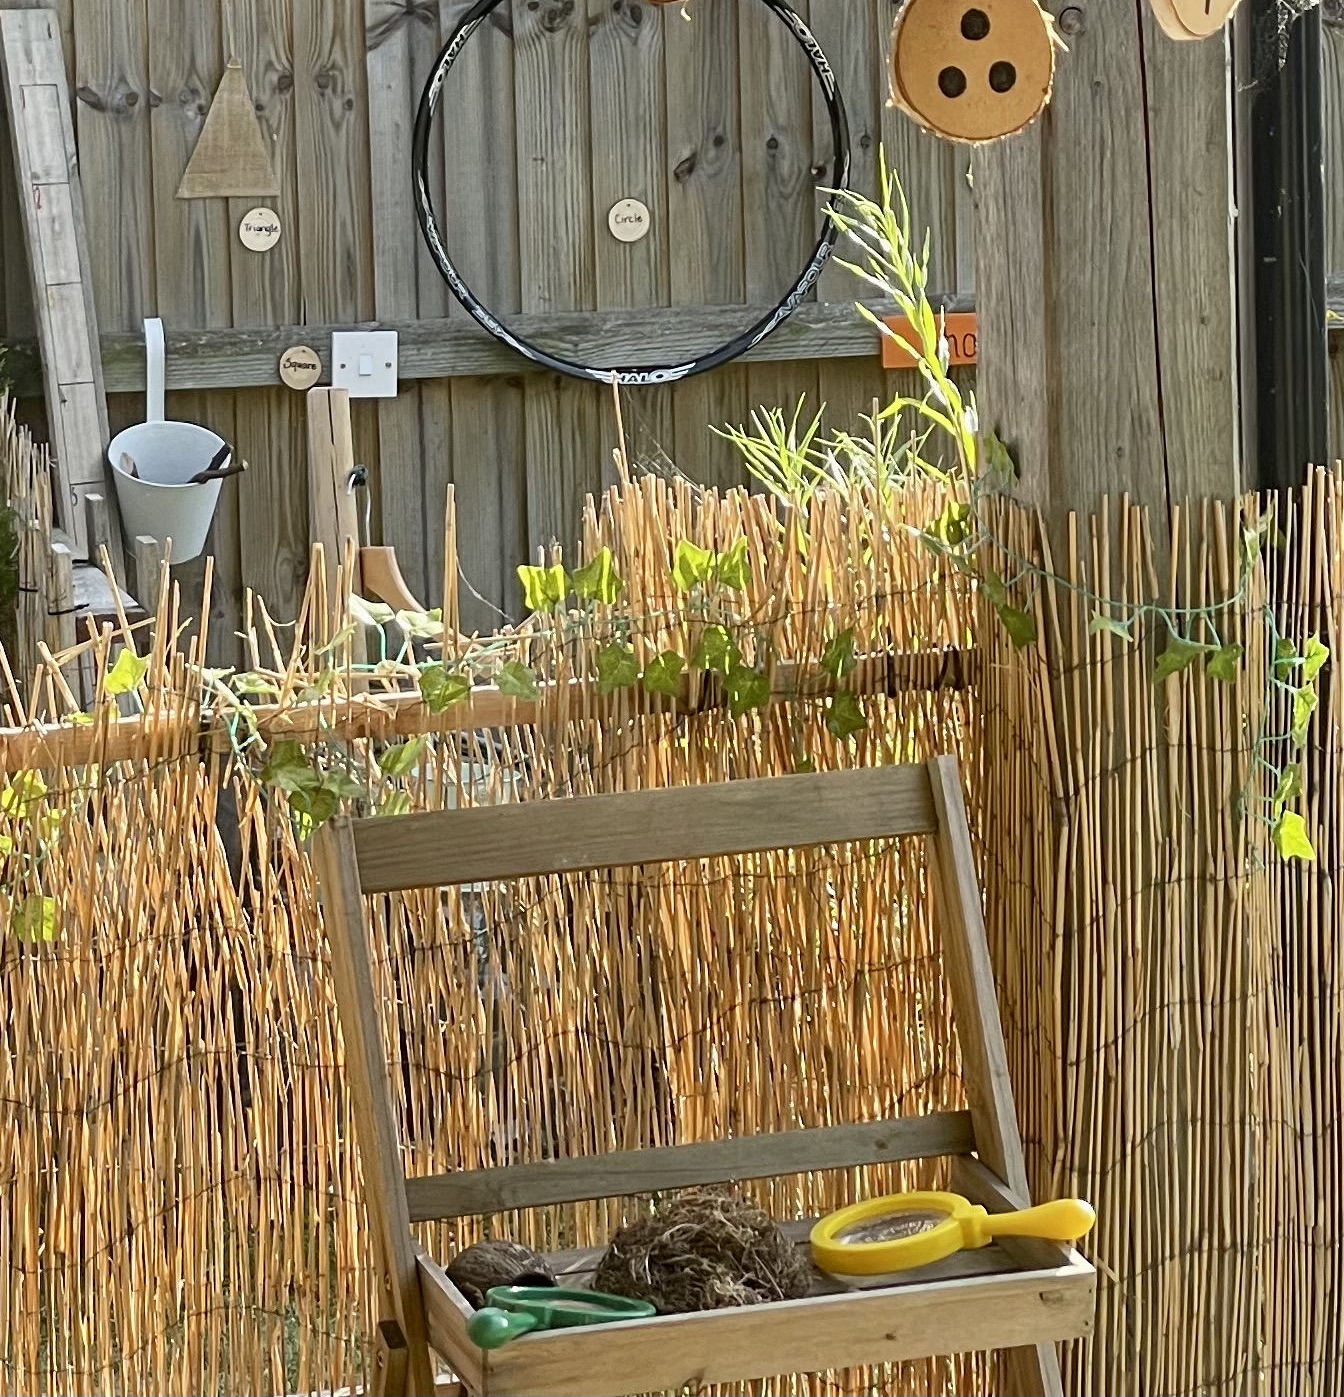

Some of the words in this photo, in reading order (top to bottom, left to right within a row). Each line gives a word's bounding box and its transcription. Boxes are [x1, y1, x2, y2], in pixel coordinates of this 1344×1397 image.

[614, 213, 644, 225] Circle
[244, 222, 279, 237] Triangle
[283, 357, 317, 372] Square
[615, 369, 671, 384] HALO
